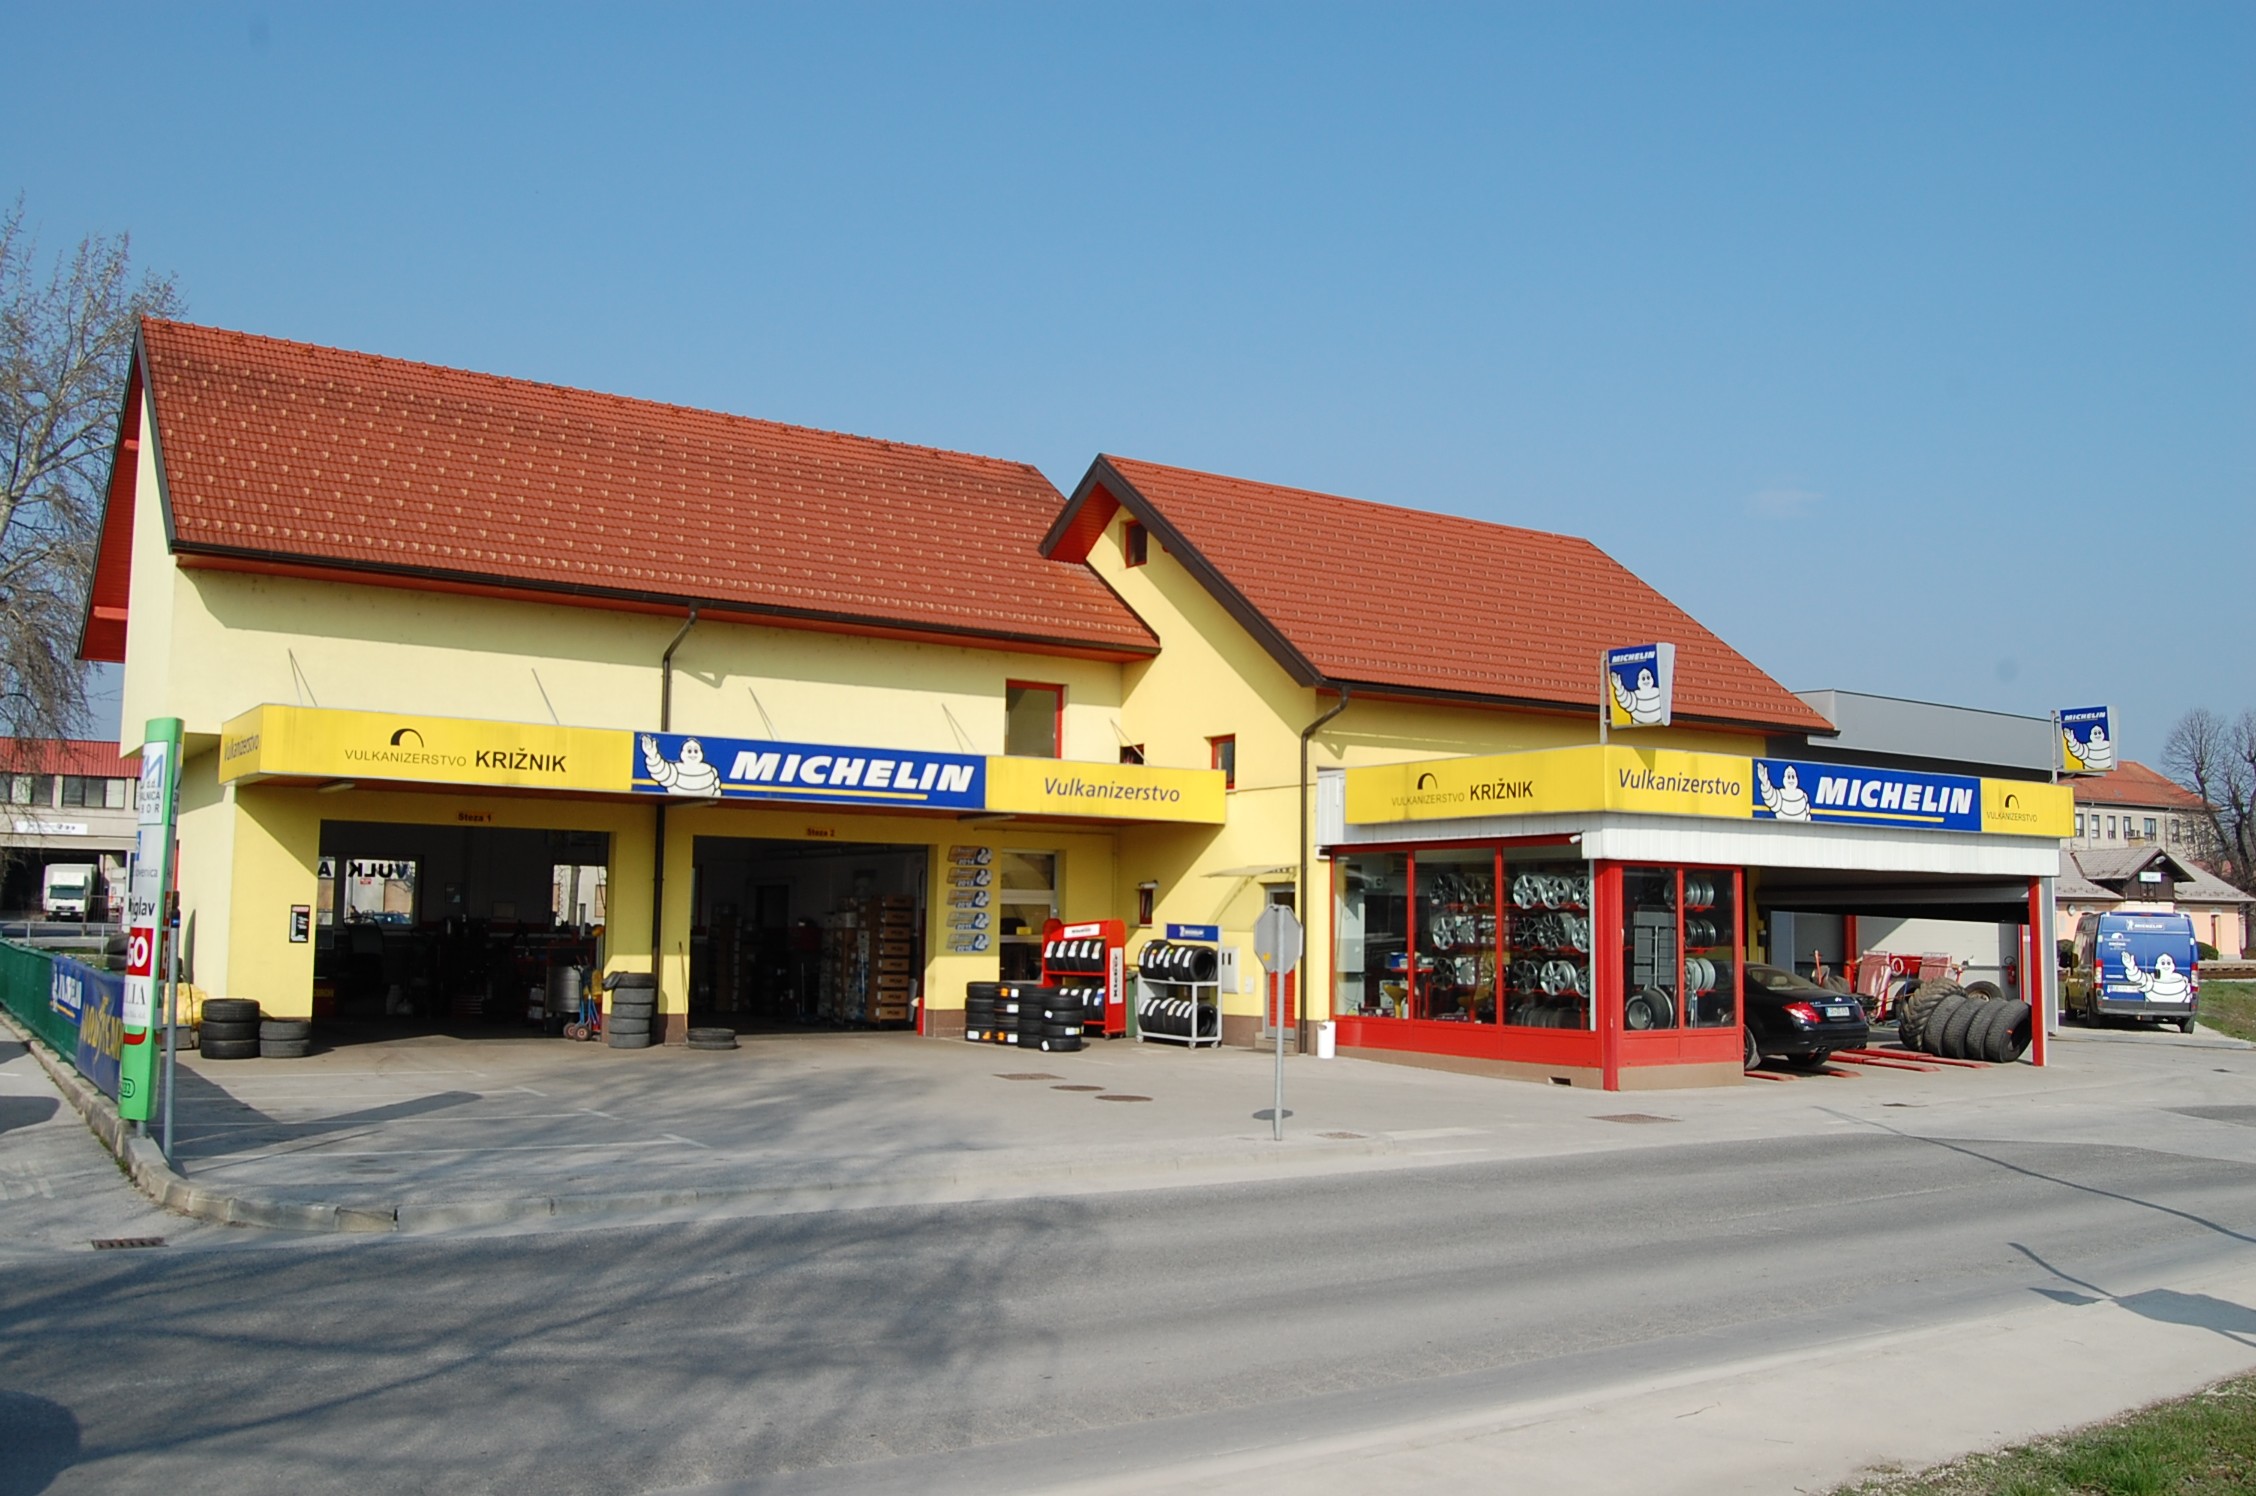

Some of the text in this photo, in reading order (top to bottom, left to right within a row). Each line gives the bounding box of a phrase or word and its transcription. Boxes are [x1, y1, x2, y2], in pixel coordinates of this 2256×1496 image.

[1611, 651, 1656, 663] MICHELIN
[2064, 711, 2106, 721] MICHELIN
[344, 748, 567, 773] VULKANIZERSTVO KRIŽNIK
[729, 750, 975, 793] MICHELIN
[1044, 776, 1181, 804] Vulkanizerstvo
[1391, 778, 1534, 806] VULKANIZERSTVO KRIŽNIK
[1619, 767, 1741, 797] Vulkanizerstvo
[1815, 776, 1973, 815] MICHELIN
[458, 812, 492, 823] Steza 1
[1986, 811, 2038, 822] VULKANIZERSTVO
